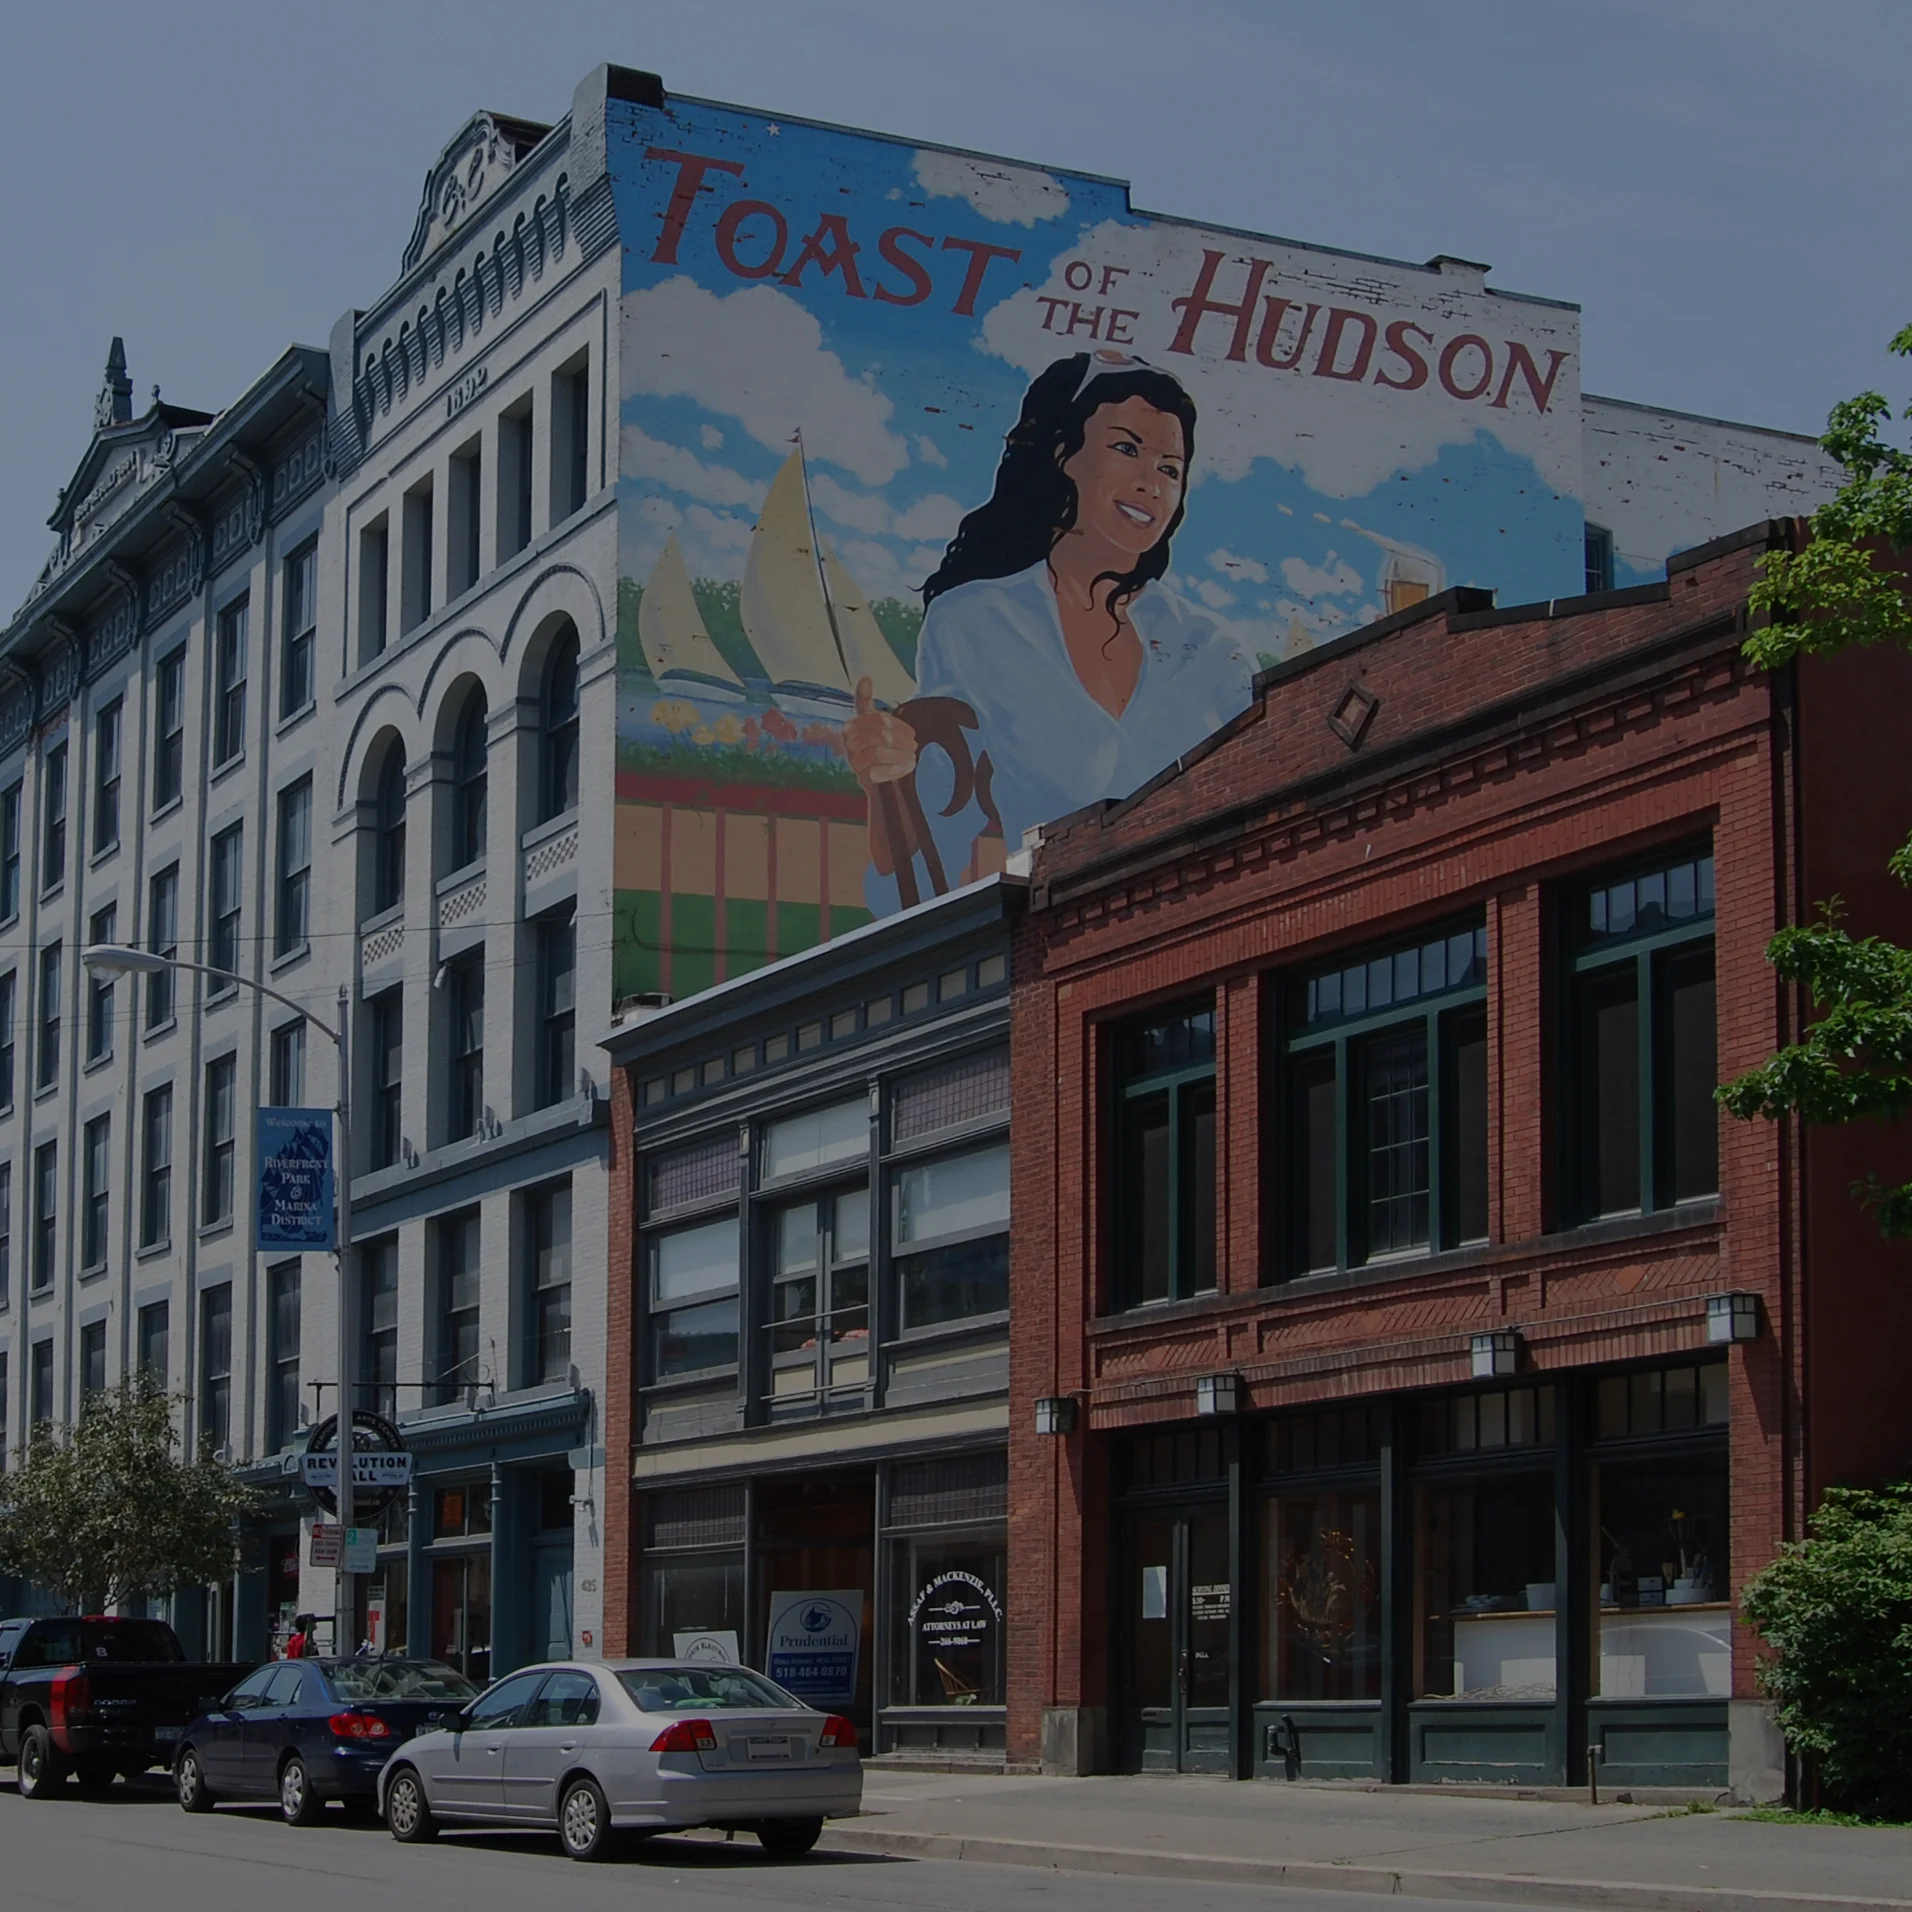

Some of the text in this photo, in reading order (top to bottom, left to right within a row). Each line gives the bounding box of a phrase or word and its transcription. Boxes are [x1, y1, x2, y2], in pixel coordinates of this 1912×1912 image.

[643, 145, 1022, 317] TOAST
[1064, 260, 1130, 296] OF
[1036, 296, 1140, 345] THE
[1167, 249, 1571, 415] HUDSON
[265, 1117, 326, 1129] Welcome to
[264, 1156, 330, 1169] RIVERFRONT
[281, 1172, 311, 1185] PARK
[290, 1186, 302, 1200] &
[274, 1199, 317, 1212] MARINA
[271, 1213, 322, 1226] DISTRICT
[307, 1457, 406, 1469] REVUTION
[922, 1620, 987, 1632] ATTORNEYS AT LAW
[780, 1633, 848, 1647] Prudential
